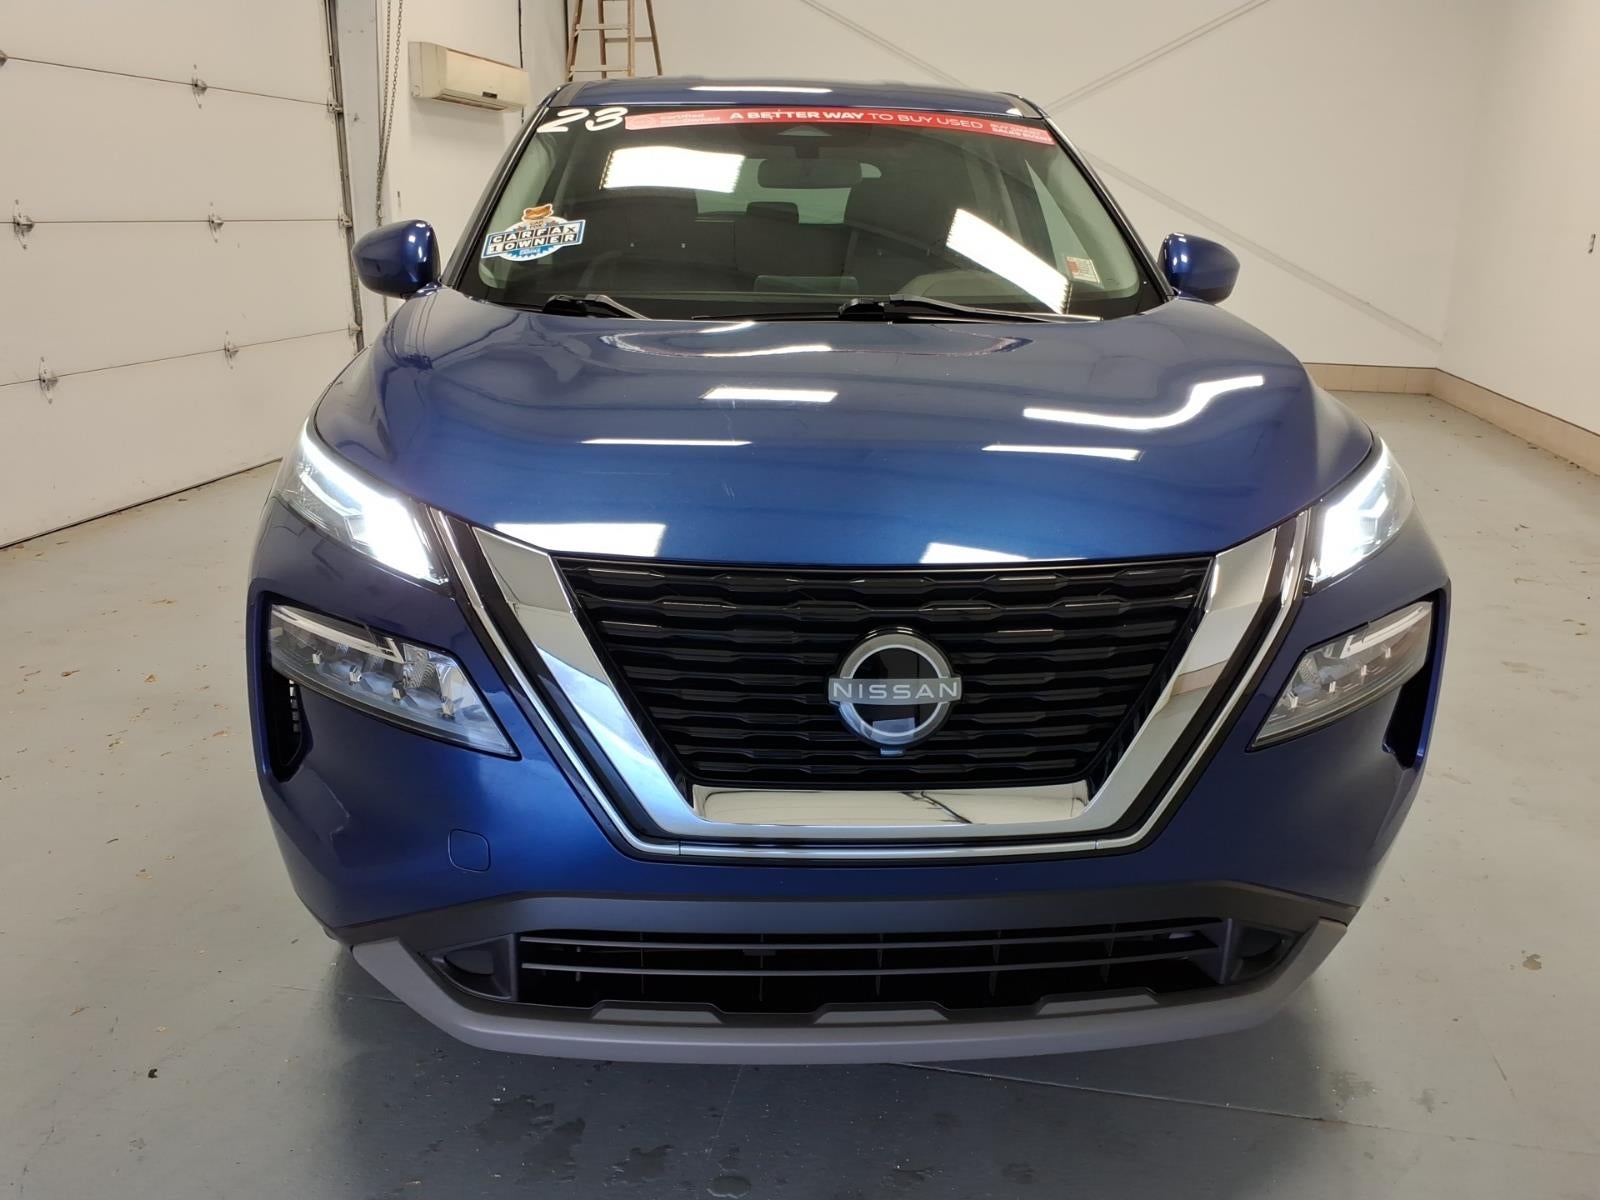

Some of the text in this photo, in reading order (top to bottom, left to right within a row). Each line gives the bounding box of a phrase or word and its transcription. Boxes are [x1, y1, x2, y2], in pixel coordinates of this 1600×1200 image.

[537, 106, 629, 133] 23
[730, 110, 983, 129] A BETTER WAY TO BUY USED
[492, 226, 577, 243] CARFAX
[504, 234, 576, 251] OWNER
[833, 681, 958, 699] NISSAN
